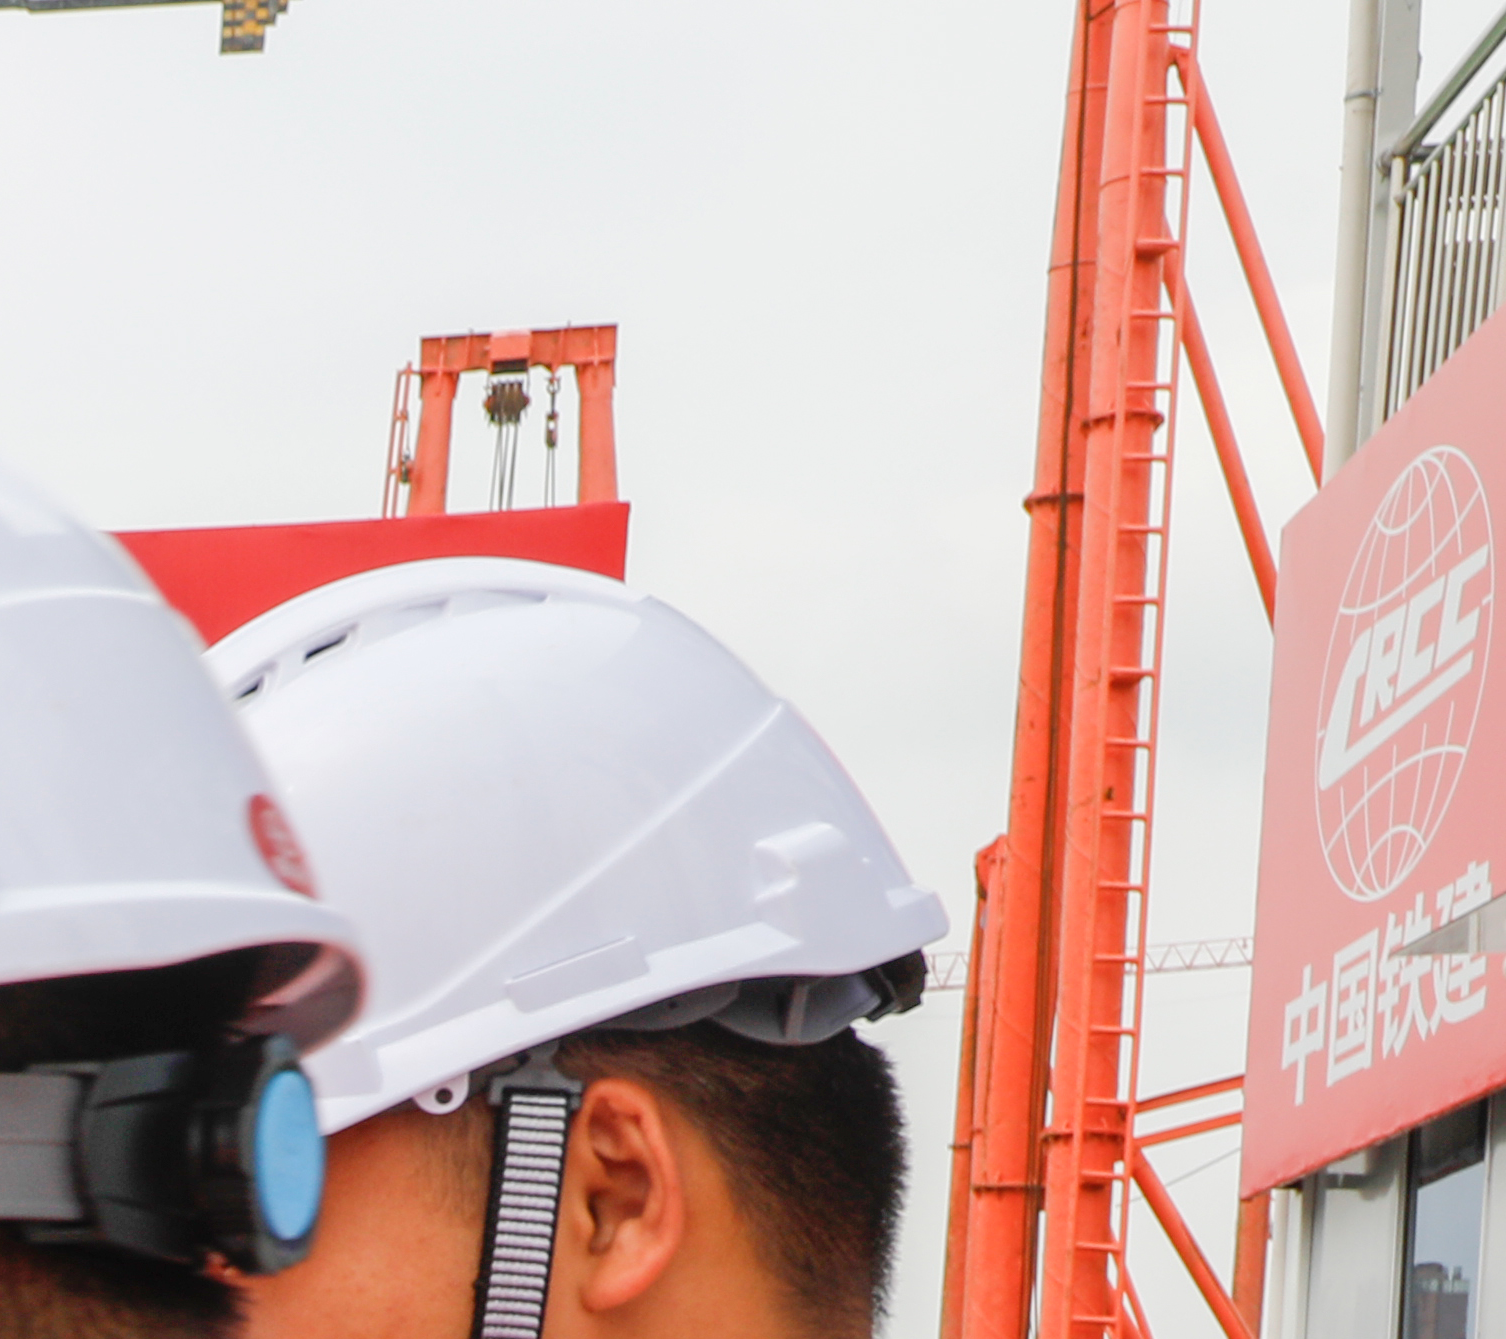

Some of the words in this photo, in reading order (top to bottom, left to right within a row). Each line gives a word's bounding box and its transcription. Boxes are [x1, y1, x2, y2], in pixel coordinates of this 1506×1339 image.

[1318, 544, 1490, 791] CRCC
[1280, 859, 1492, 1106] 中国铁建
